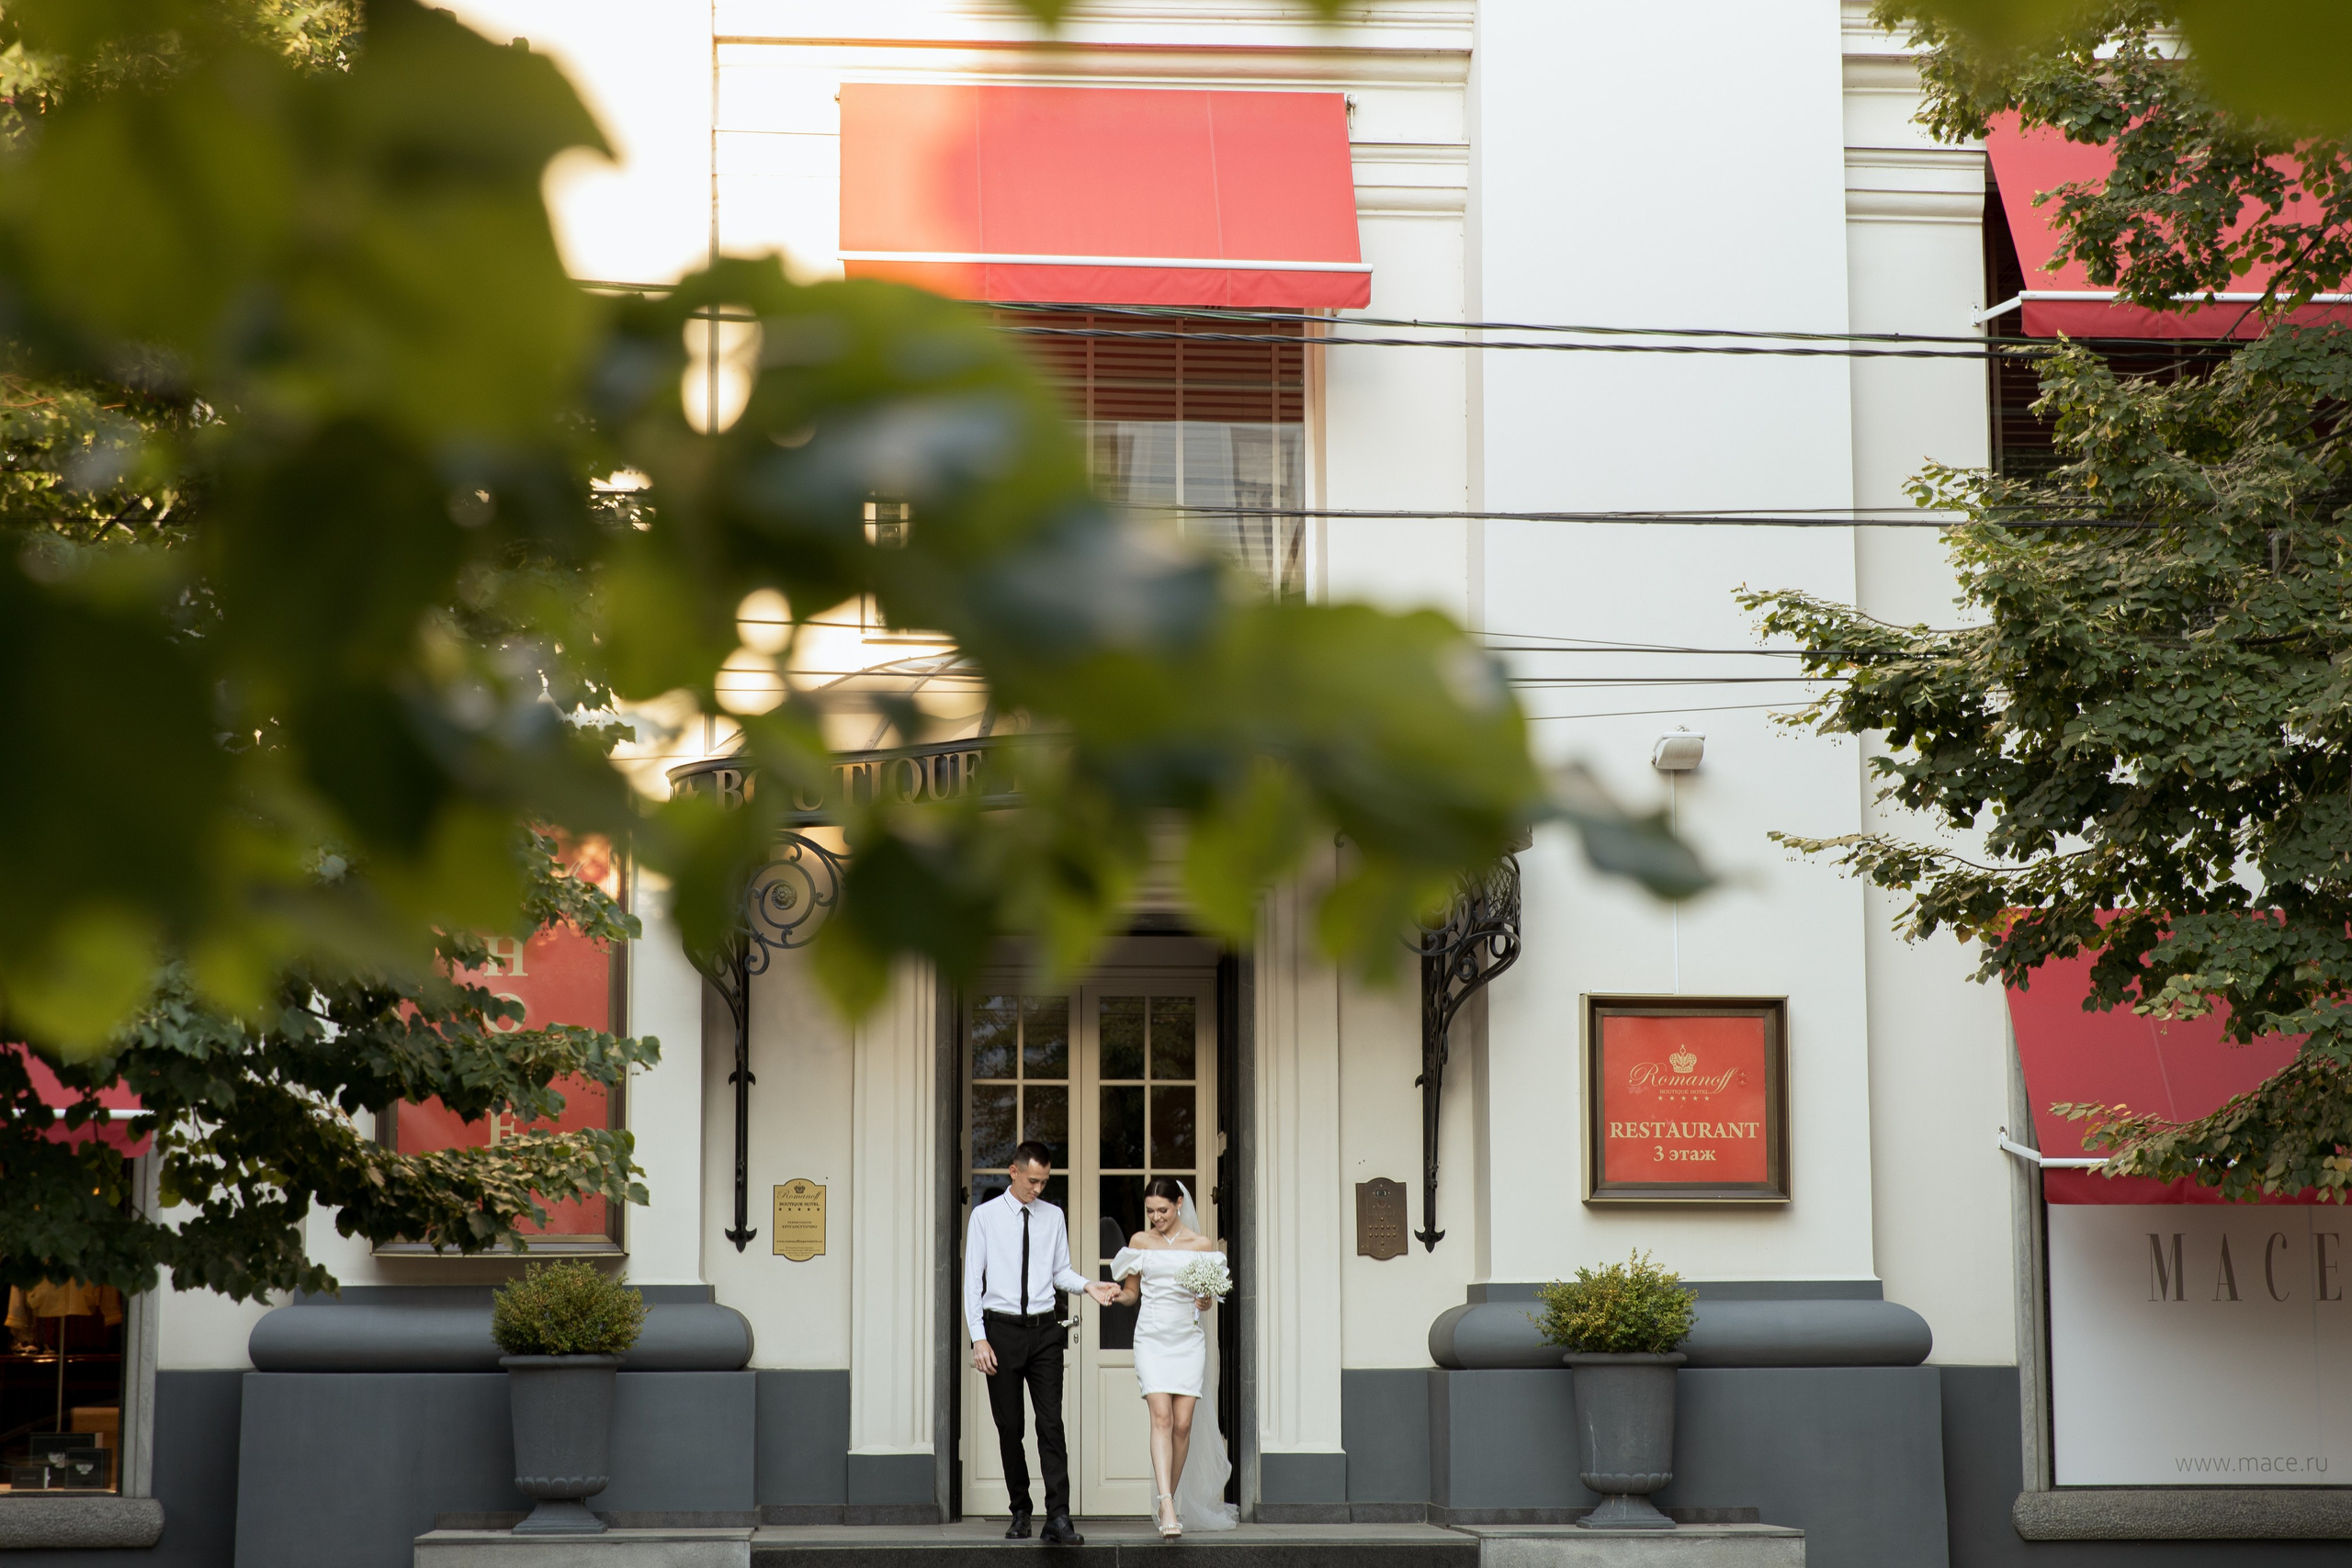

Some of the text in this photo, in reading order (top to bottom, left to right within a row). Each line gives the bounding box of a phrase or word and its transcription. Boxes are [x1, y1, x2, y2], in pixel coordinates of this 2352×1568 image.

[1629, 1062, 1738, 1094] Romanoff
[1610, 1122, 1759, 1139] RESTAURANT
[1654, 1145, 1716, 1162] 3 этаж
[776, 1190, 821, 1201] Romanoff
[2145, 1232, 2343, 1302] MACE
[2175, 1456, 2328, 1472] www.mace.ru
